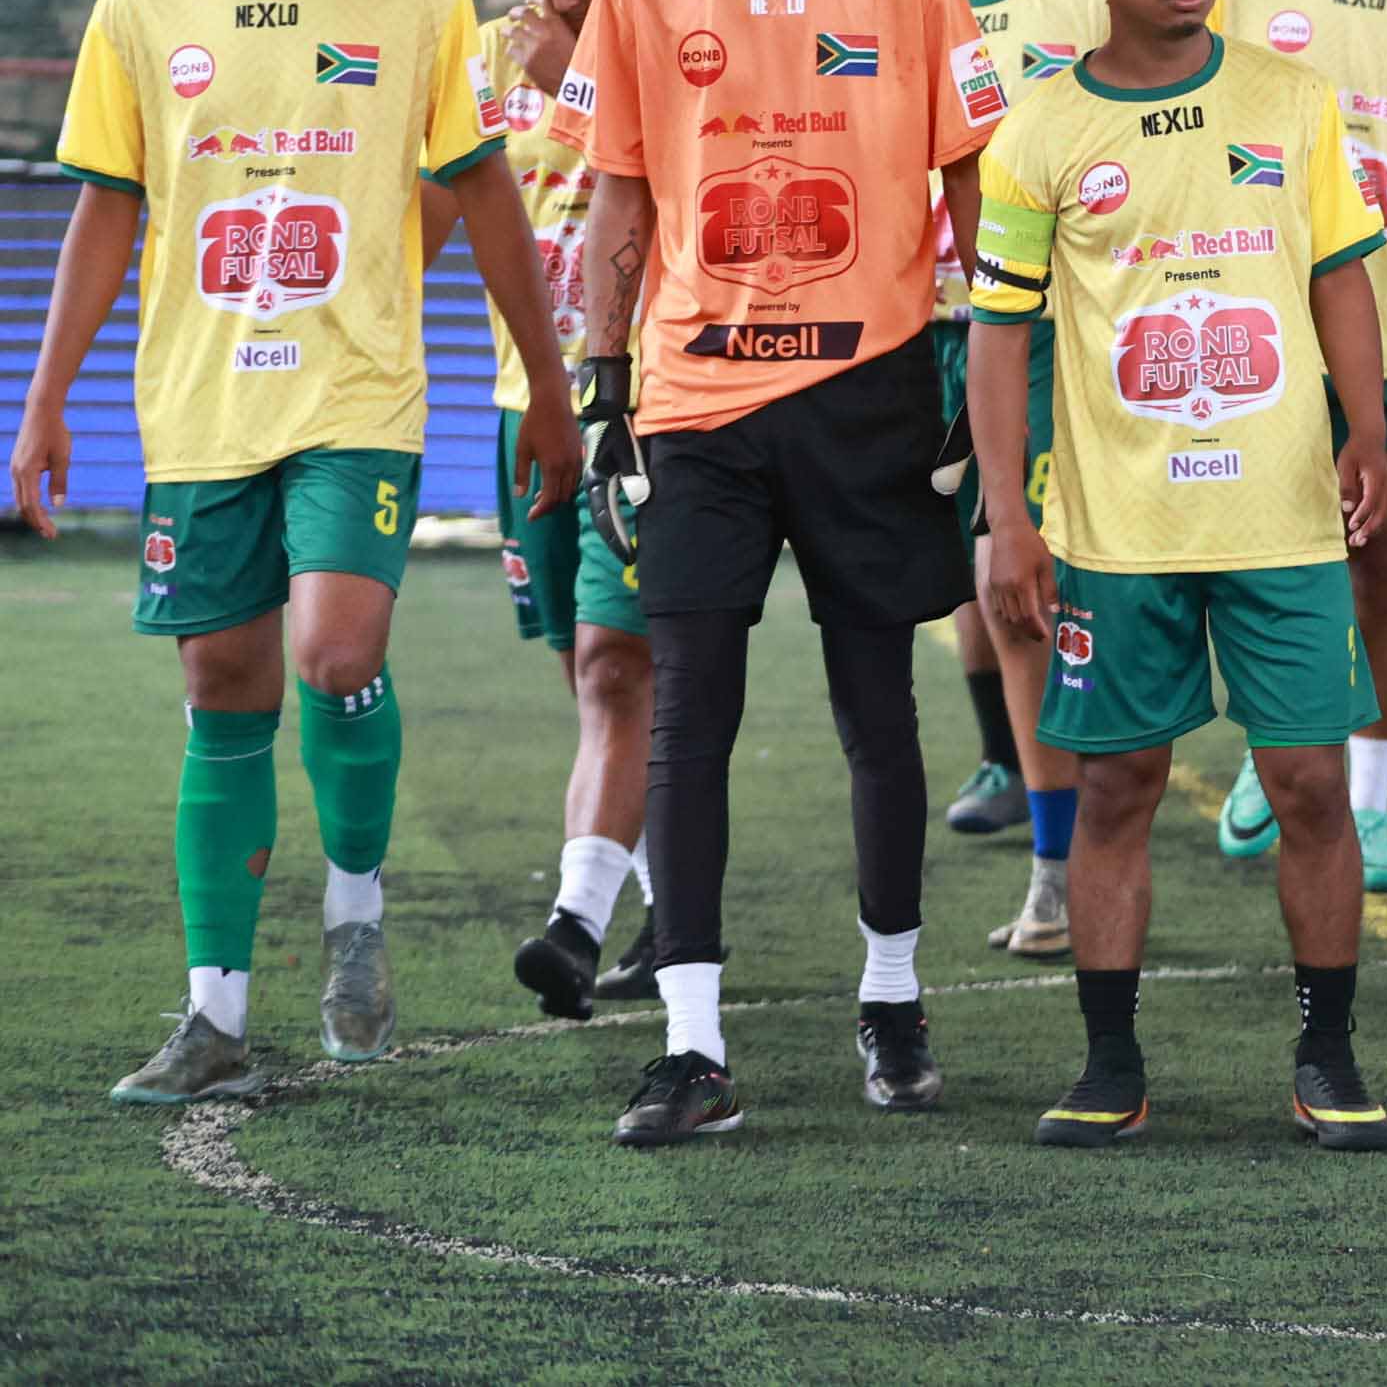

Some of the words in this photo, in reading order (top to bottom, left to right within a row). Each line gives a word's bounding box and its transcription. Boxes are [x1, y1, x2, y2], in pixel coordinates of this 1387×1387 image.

[235, 2, 299, 28] NEXLO
[976, 13, 1008, 34] XLO
[682, 49, 721, 63] RONB
[171, 62, 211, 77] RONB
[563, 81, 595, 110] ell
[772, 113, 806, 133] Red
[810, 111, 847, 132] Bull
[1141, 106, 1204, 137] NEXLO
[275, 131, 310, 153] Red
[315, 130, 354, 153] Bull
[752, 139, 793, 150] Presents
[729, 195, 819, 225] RONB
[225, 220, 318, 254] RONB
[724, 225, 827, 255] FUTSAL
[1191, 230, 1233, 255] Red
[1236, 229, 1274, 252] Bull
[220, 252, 324, 285] FUTSAL
[1165, 267, 1221, 282] Presents
[789, 302, 801, 313] by
[727, 325, 819, 357] Ncell
[1144, 324, 1250, 361] RONB
[235, 345, 297, 367] Ncell
[1140, 357, 1259, 392] FUTSAL
[1172, 453, 1238, 478] Ncell
[373, 478, 399, 535] 5
